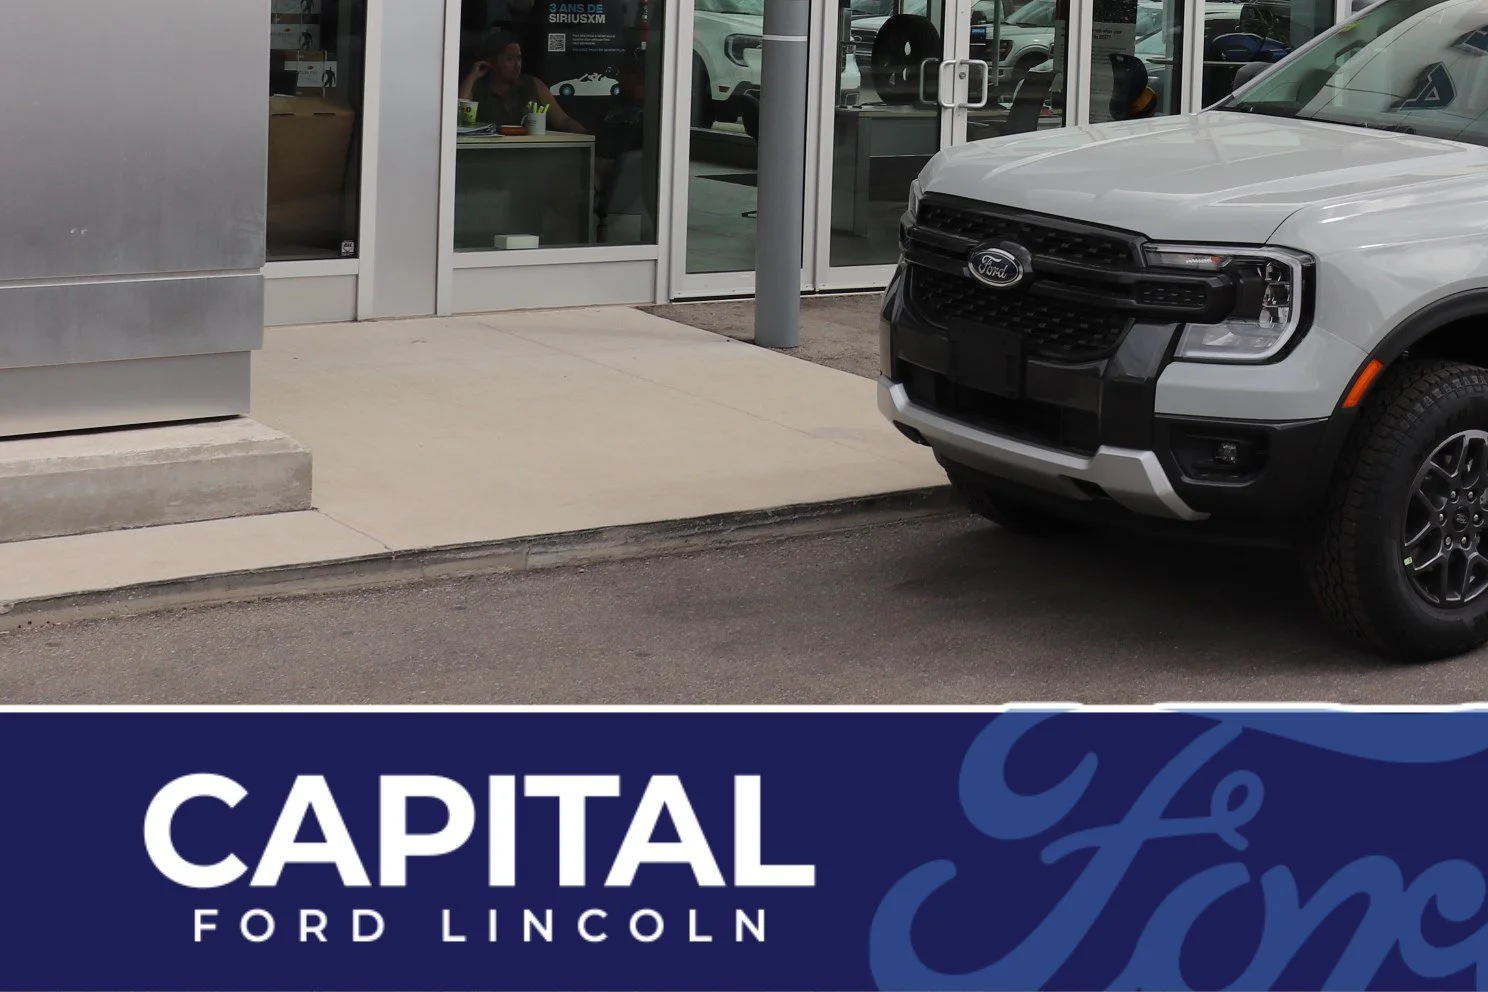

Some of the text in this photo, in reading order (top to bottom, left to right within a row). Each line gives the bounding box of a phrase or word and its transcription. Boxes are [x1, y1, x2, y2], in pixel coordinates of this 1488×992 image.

[549, 3, 604, 14] 3 ANS DE
[549, 13, 606, 24] SIRIUSXM
[978, 254, 1009, 279] Ford
